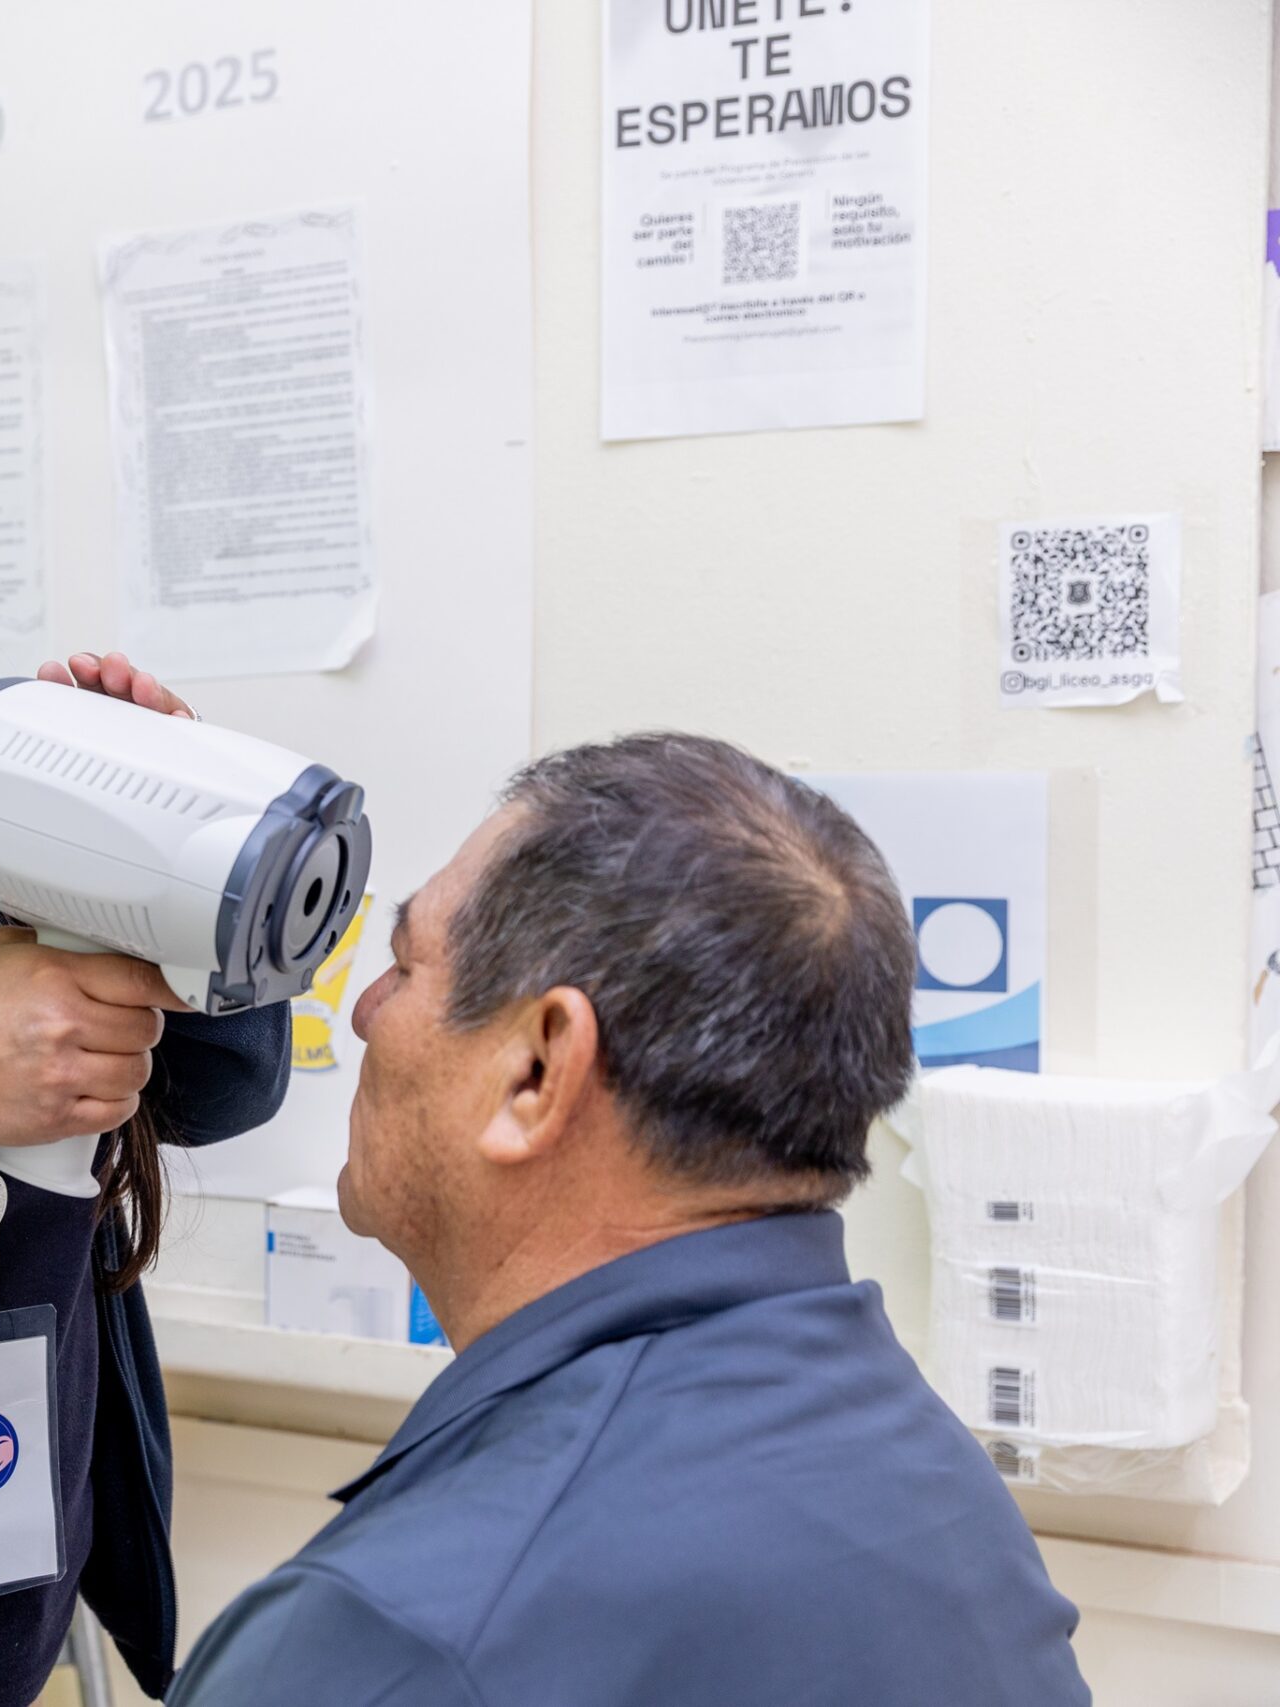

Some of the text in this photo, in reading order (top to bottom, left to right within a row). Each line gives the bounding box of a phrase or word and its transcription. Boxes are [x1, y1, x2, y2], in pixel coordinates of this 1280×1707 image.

[731, 34, 791, 80] TE
[143, 49, 279, 123] 2025
[616, 76, 911, 149] ESPERAMOS
[640, 212, 694, 228] Quieres
[632, 226, 694, 242] ser parte
[671, 239, 693, 252] del
[636, 253, 686, 268] cambio
